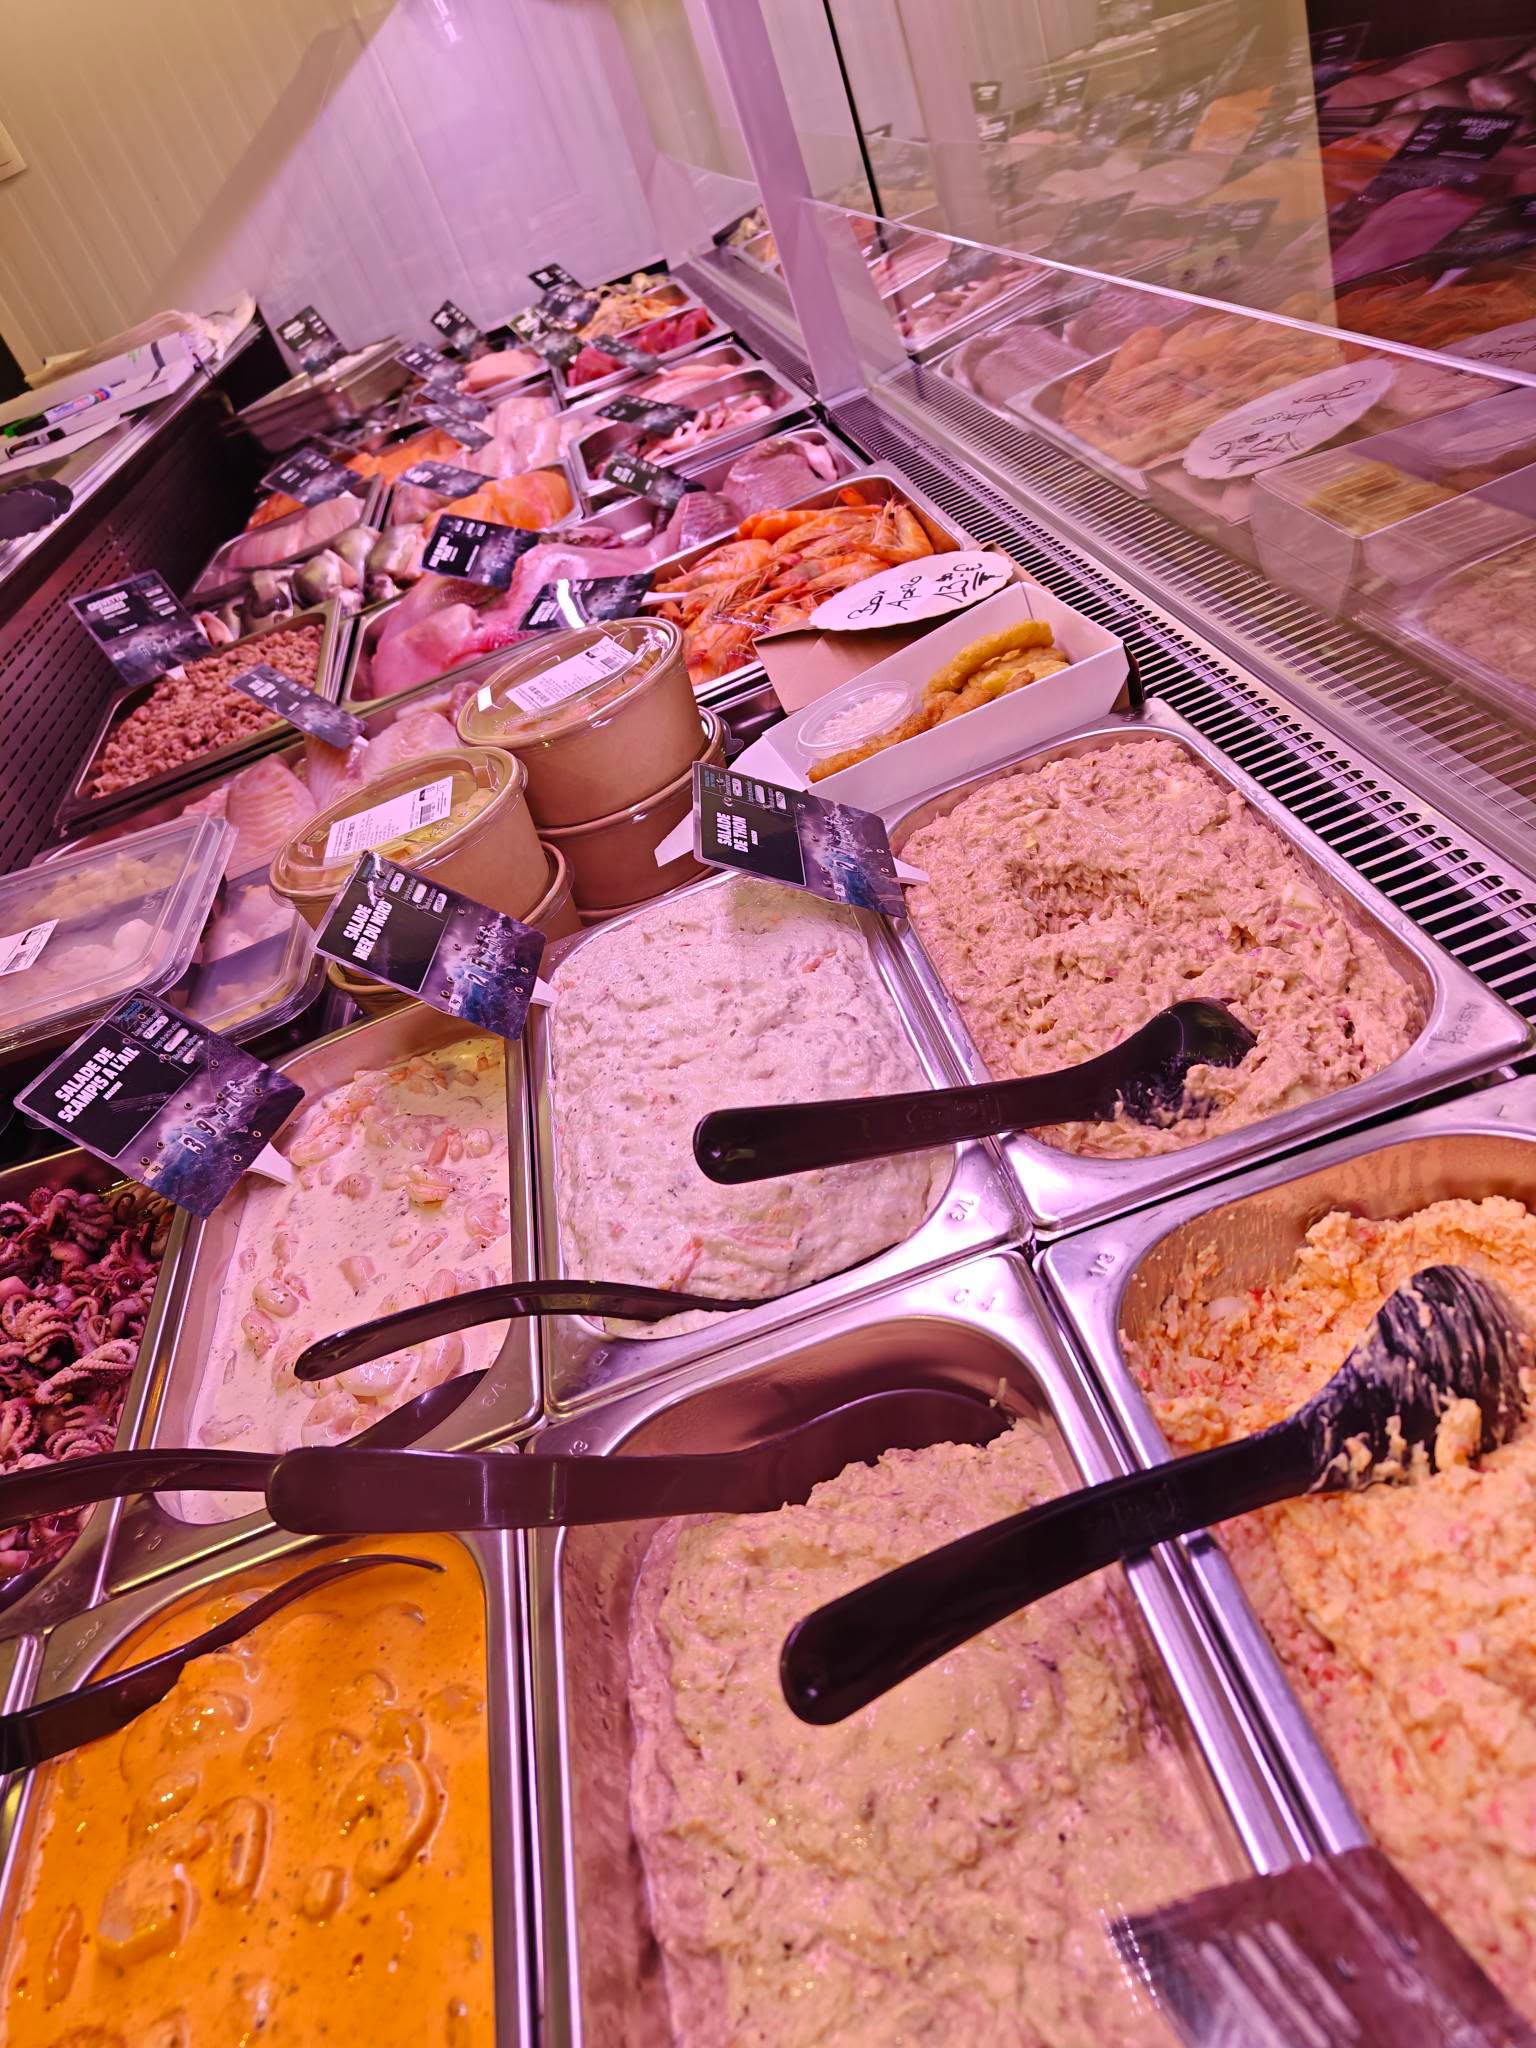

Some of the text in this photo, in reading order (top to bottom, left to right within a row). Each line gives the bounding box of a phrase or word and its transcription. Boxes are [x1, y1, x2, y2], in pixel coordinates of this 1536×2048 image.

[716, 811, 733, 847] SALADE
[731, 814, 749, 853] DE THON
[342, 903, 373, 941] SALADE
[352, 900, 393, 961] MER DU NORD
[54, 1046, 116, 1102] SALADE DE
[57, 1046, 140, 1123] SCAMPIS A L'AIL
